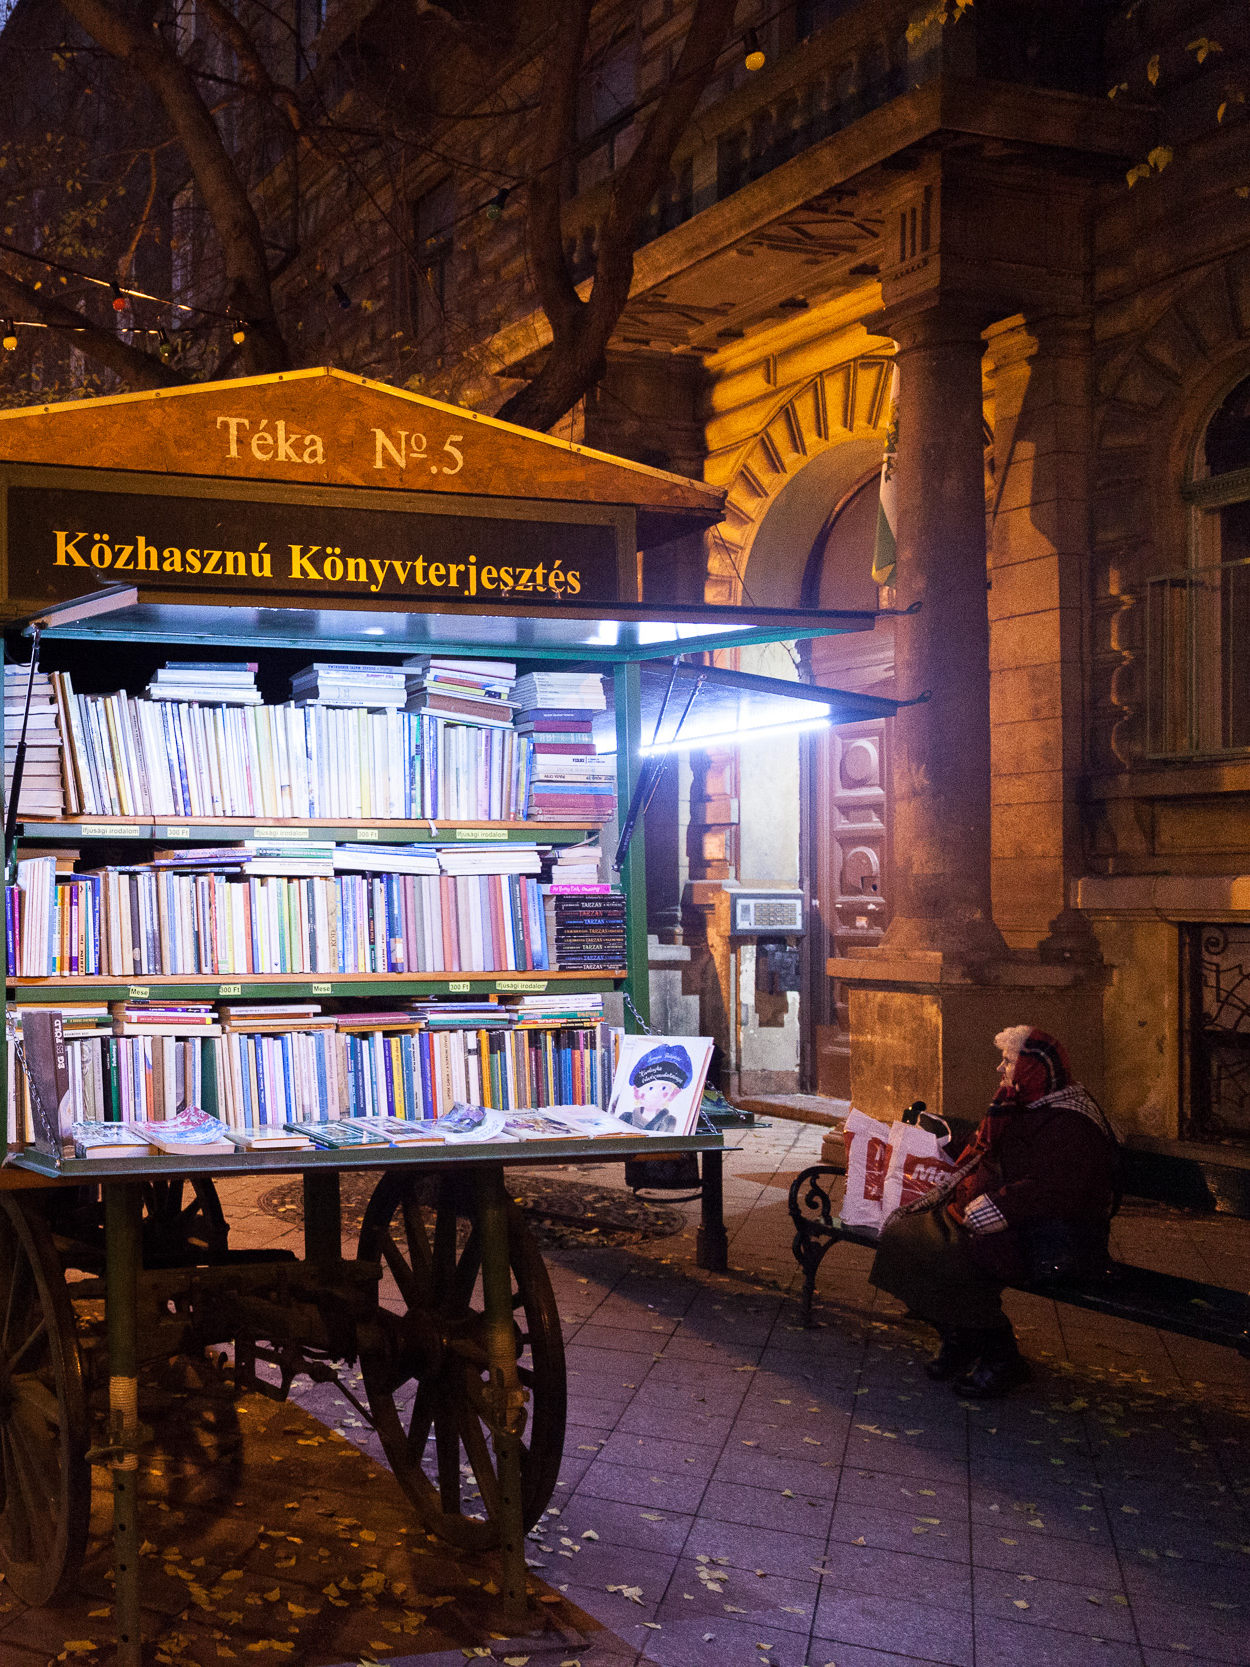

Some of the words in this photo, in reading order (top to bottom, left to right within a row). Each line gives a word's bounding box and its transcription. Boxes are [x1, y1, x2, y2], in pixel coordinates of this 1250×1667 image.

[217, 415, 327, 465] Téka
[52, 530, 273, 579] Közhasznú
[287, 543, 582, 596] Könyvterjesztés
[130, 988, 148, 996] Mese
